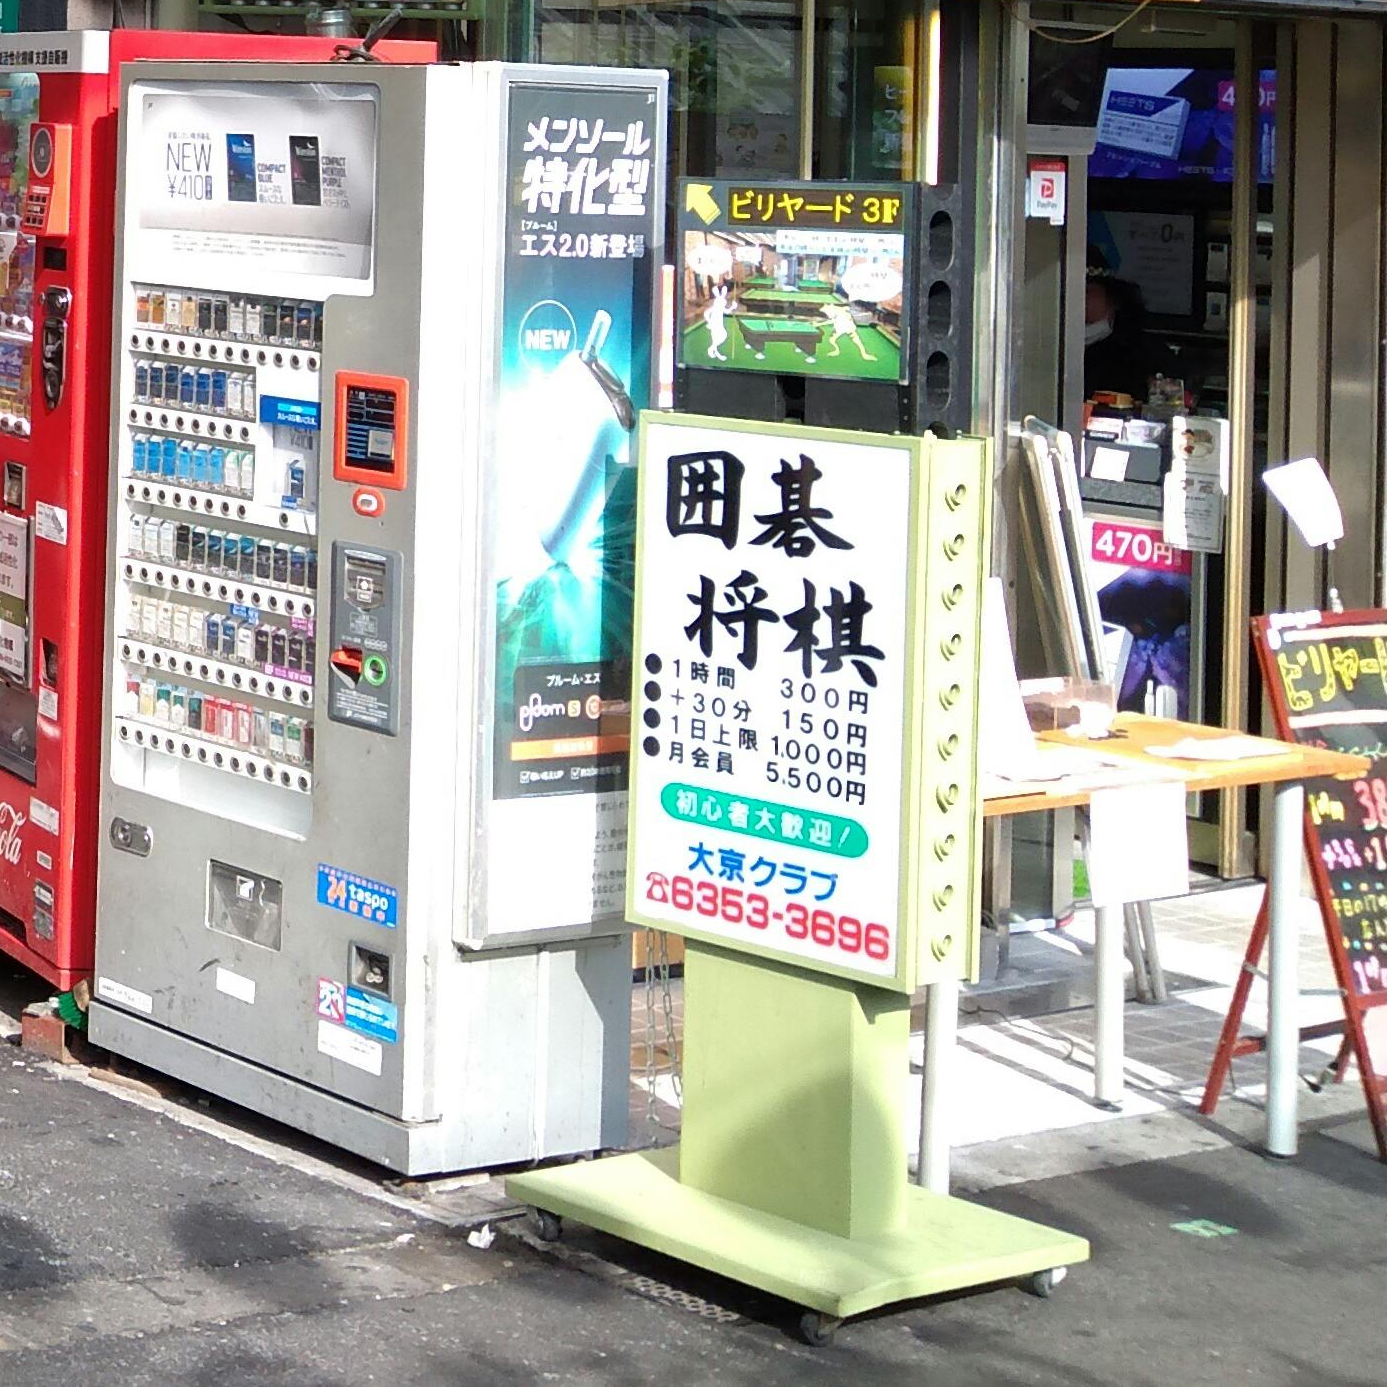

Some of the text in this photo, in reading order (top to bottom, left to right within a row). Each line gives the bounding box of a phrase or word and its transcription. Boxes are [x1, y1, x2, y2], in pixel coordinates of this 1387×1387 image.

[524, 116, 651, 156] メンソール
[166, 142, 212, 172] NEW
[521, 156, 650, 216] 特化型
[731, 190, 900, 225] ビリヤード 3F
[525, 328, 571, 352] NEW
[665, 450, 855, 558] 囲碁
[1095, 529, 1173, 565] 470円
[682, 569, 887, 689] 将棋
[667, 745, 736, 776] 月会員
[687, 842, 839, 902] 大京クラブ
[348, 883, 389, 911] taspo
